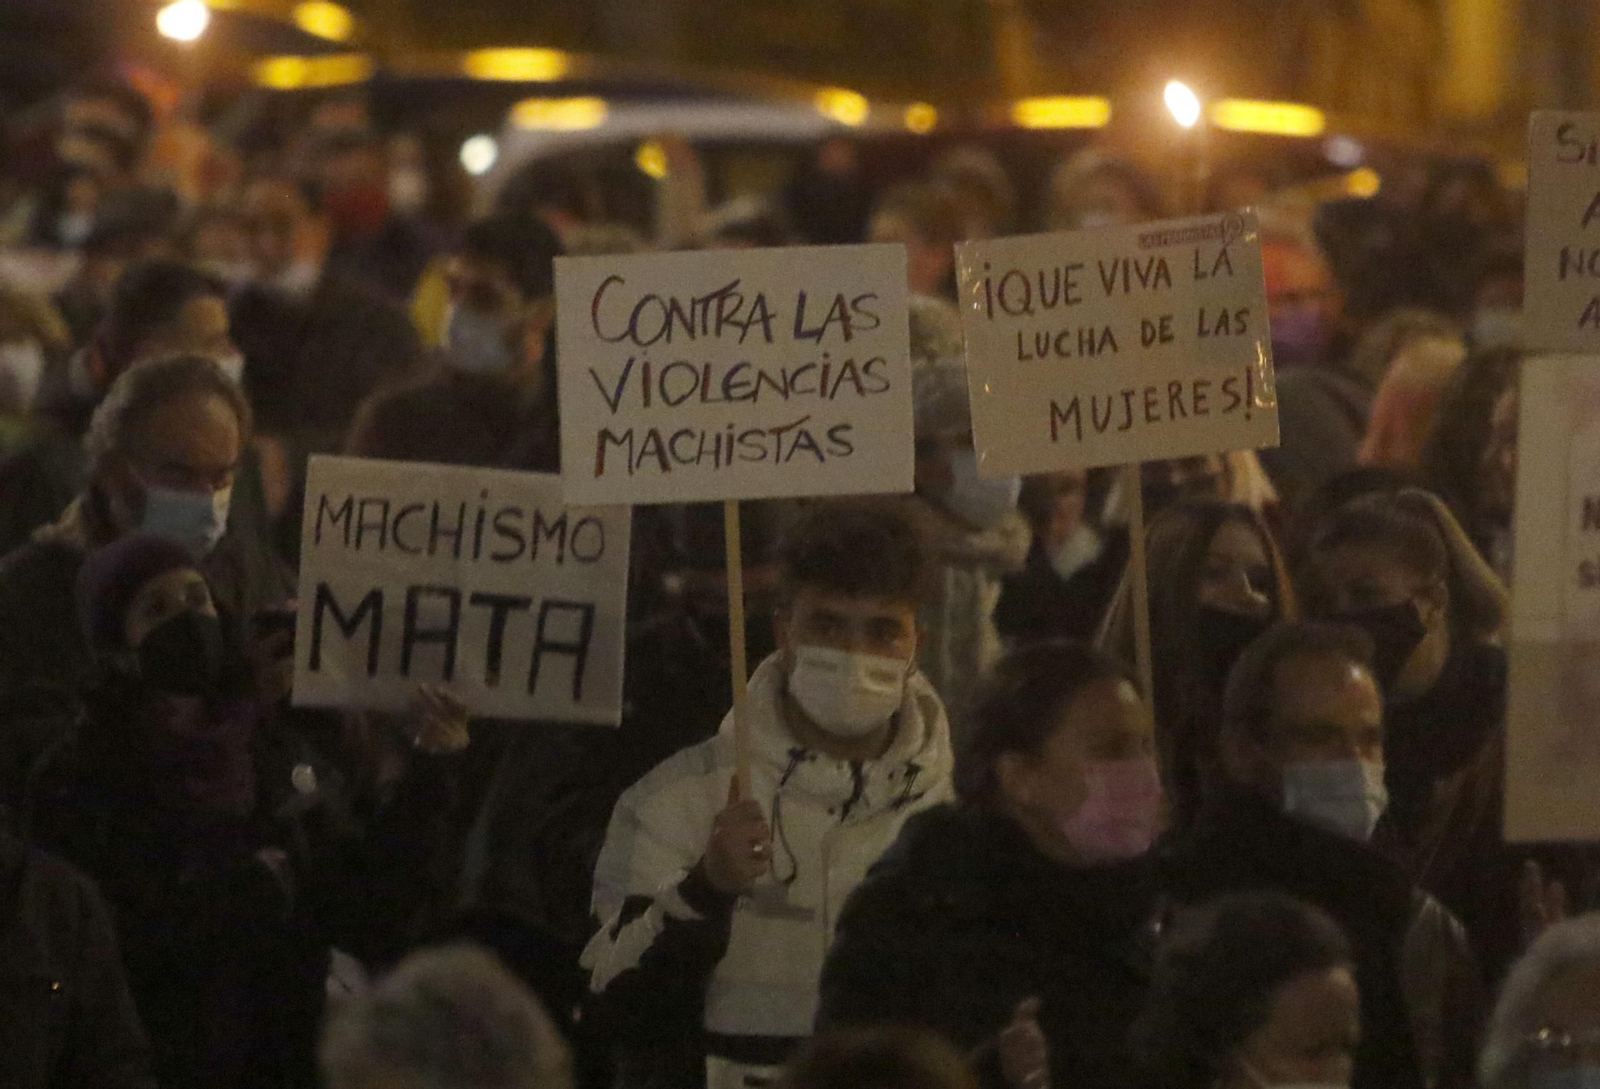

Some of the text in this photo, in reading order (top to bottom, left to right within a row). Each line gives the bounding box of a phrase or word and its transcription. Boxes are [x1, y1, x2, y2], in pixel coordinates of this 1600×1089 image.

[591, 275, 880, 346] CONTRA LAS
[984, 248, 1233, 320] ¡QUE VIVA LA
[1017, 308, 1251, 361] LUCHA DE LAS
[589, 352, 891, 415] VIOLENCIAS
[1050, 366, 1253, 442] MUJERES!
[594, 415, 855, 478] MACHISTAS
[314, 488, 606, 565] MACHISMO
[309, 581, 596, 701] MATA
